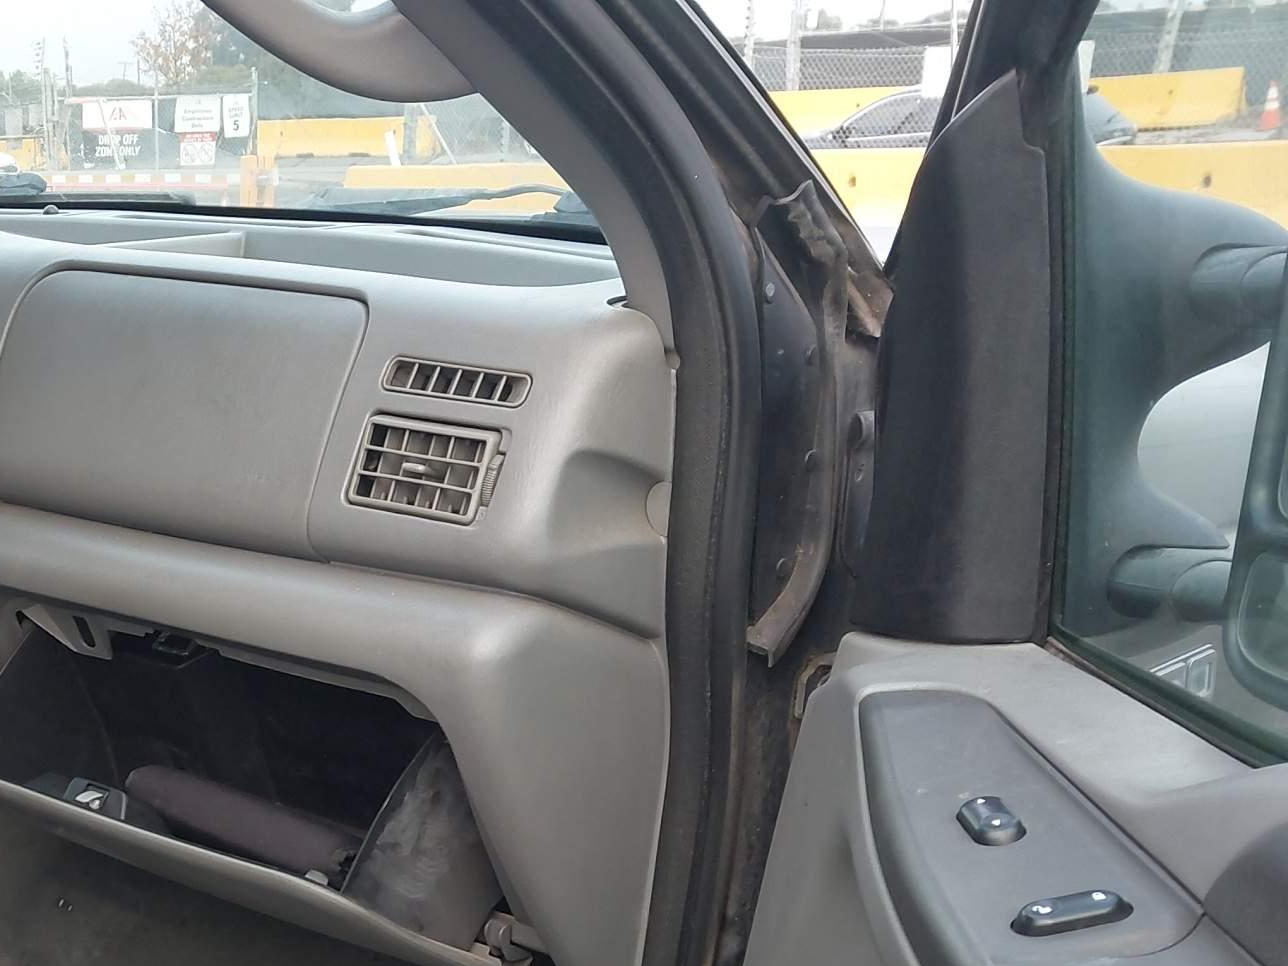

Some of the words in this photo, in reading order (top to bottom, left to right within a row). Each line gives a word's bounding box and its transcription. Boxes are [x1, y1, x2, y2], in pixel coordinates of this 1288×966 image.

[232, 119, 240, 131] 5
[122, 134, 139, 145] OFF
[119, 145, 141, 157] ONLY
